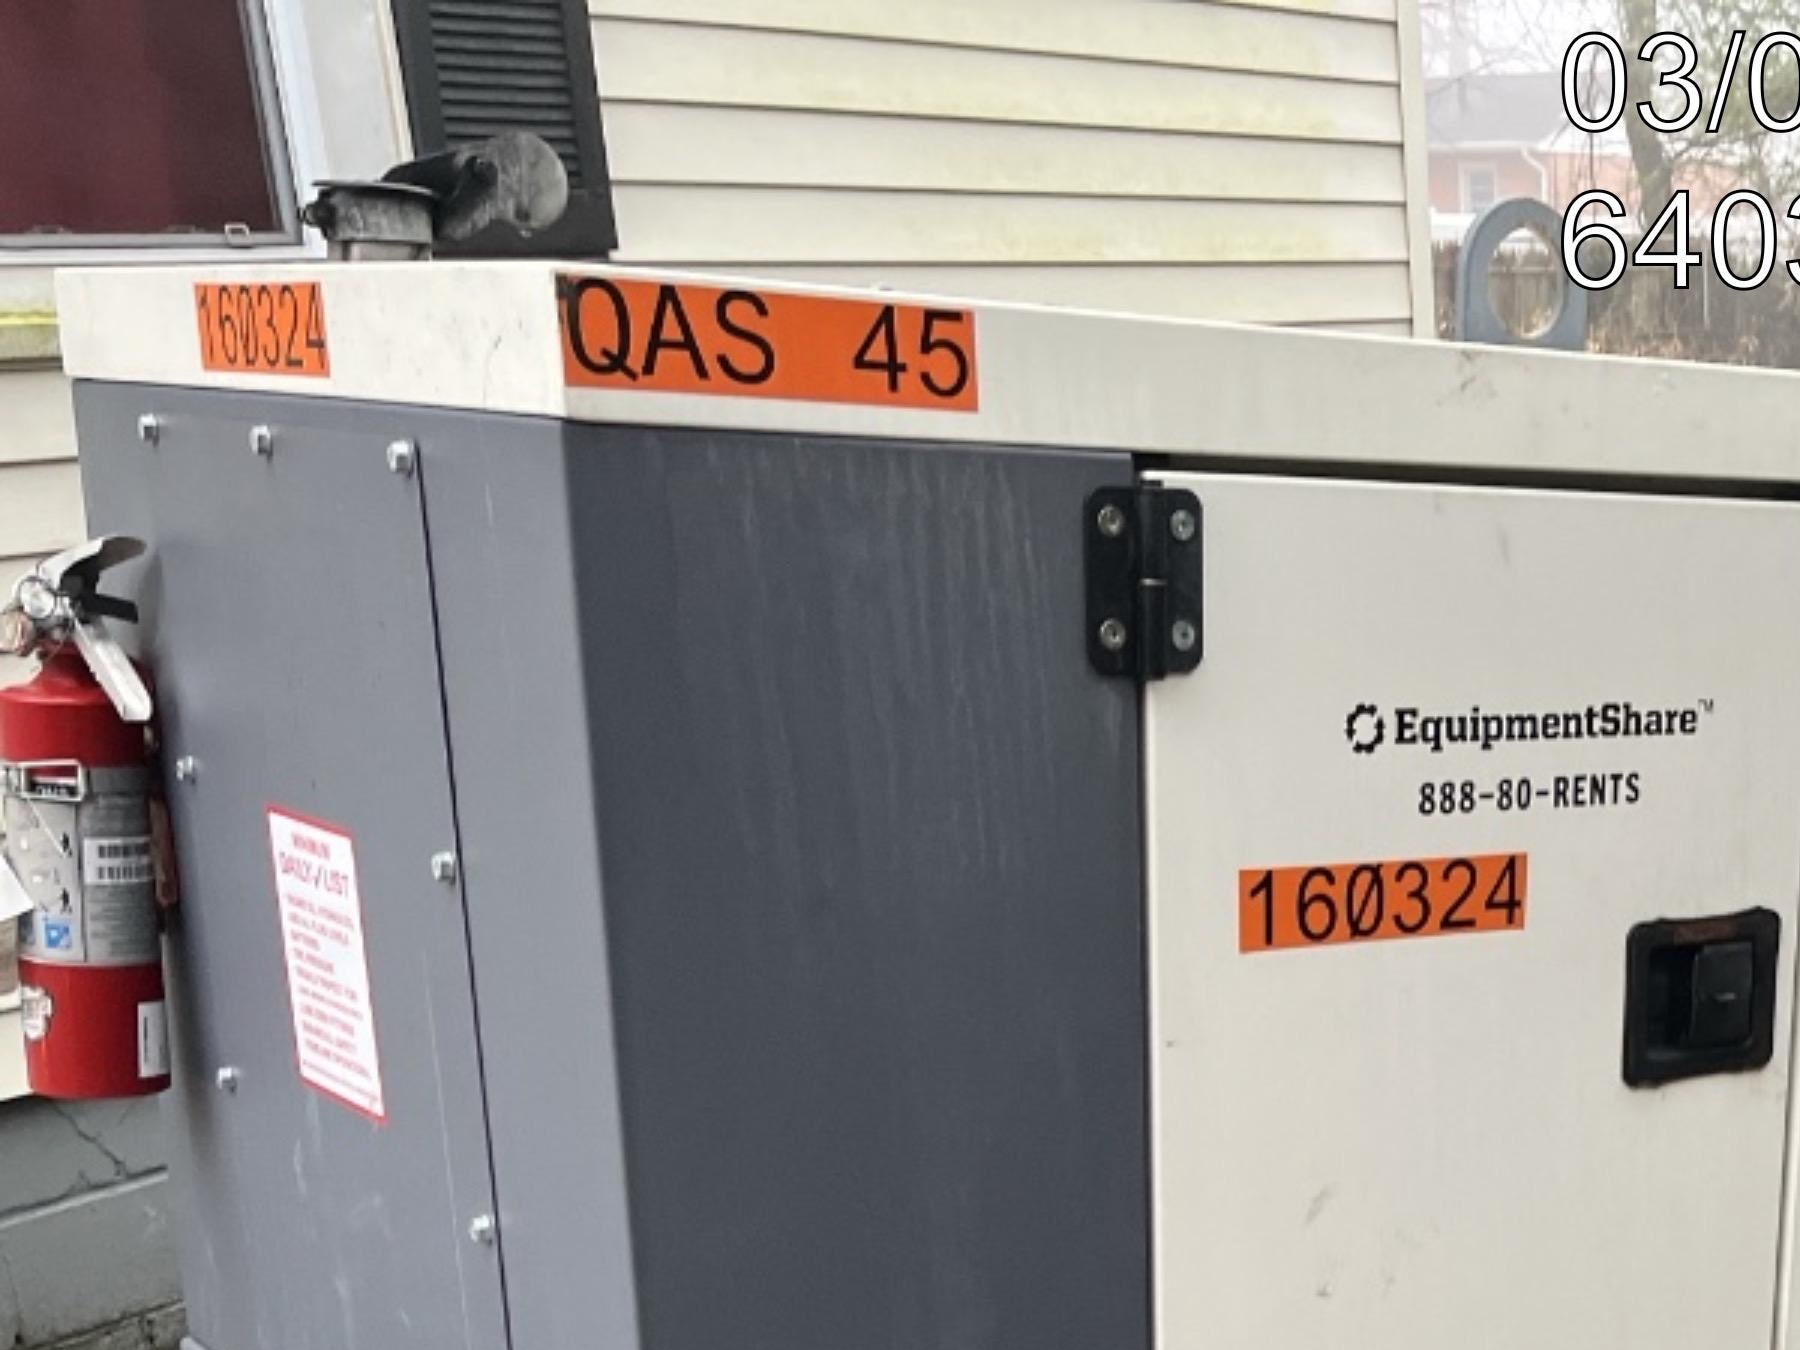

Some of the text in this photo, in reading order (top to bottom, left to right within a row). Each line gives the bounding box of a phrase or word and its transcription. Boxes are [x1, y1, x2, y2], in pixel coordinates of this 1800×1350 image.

[199, 284, 326, 370] 160324
[565, 277, 970, 398] QAS 45
[1418, 772, 1641, 816] 888-80-RENTS
[1249, 854, 1522, 946] 160324
